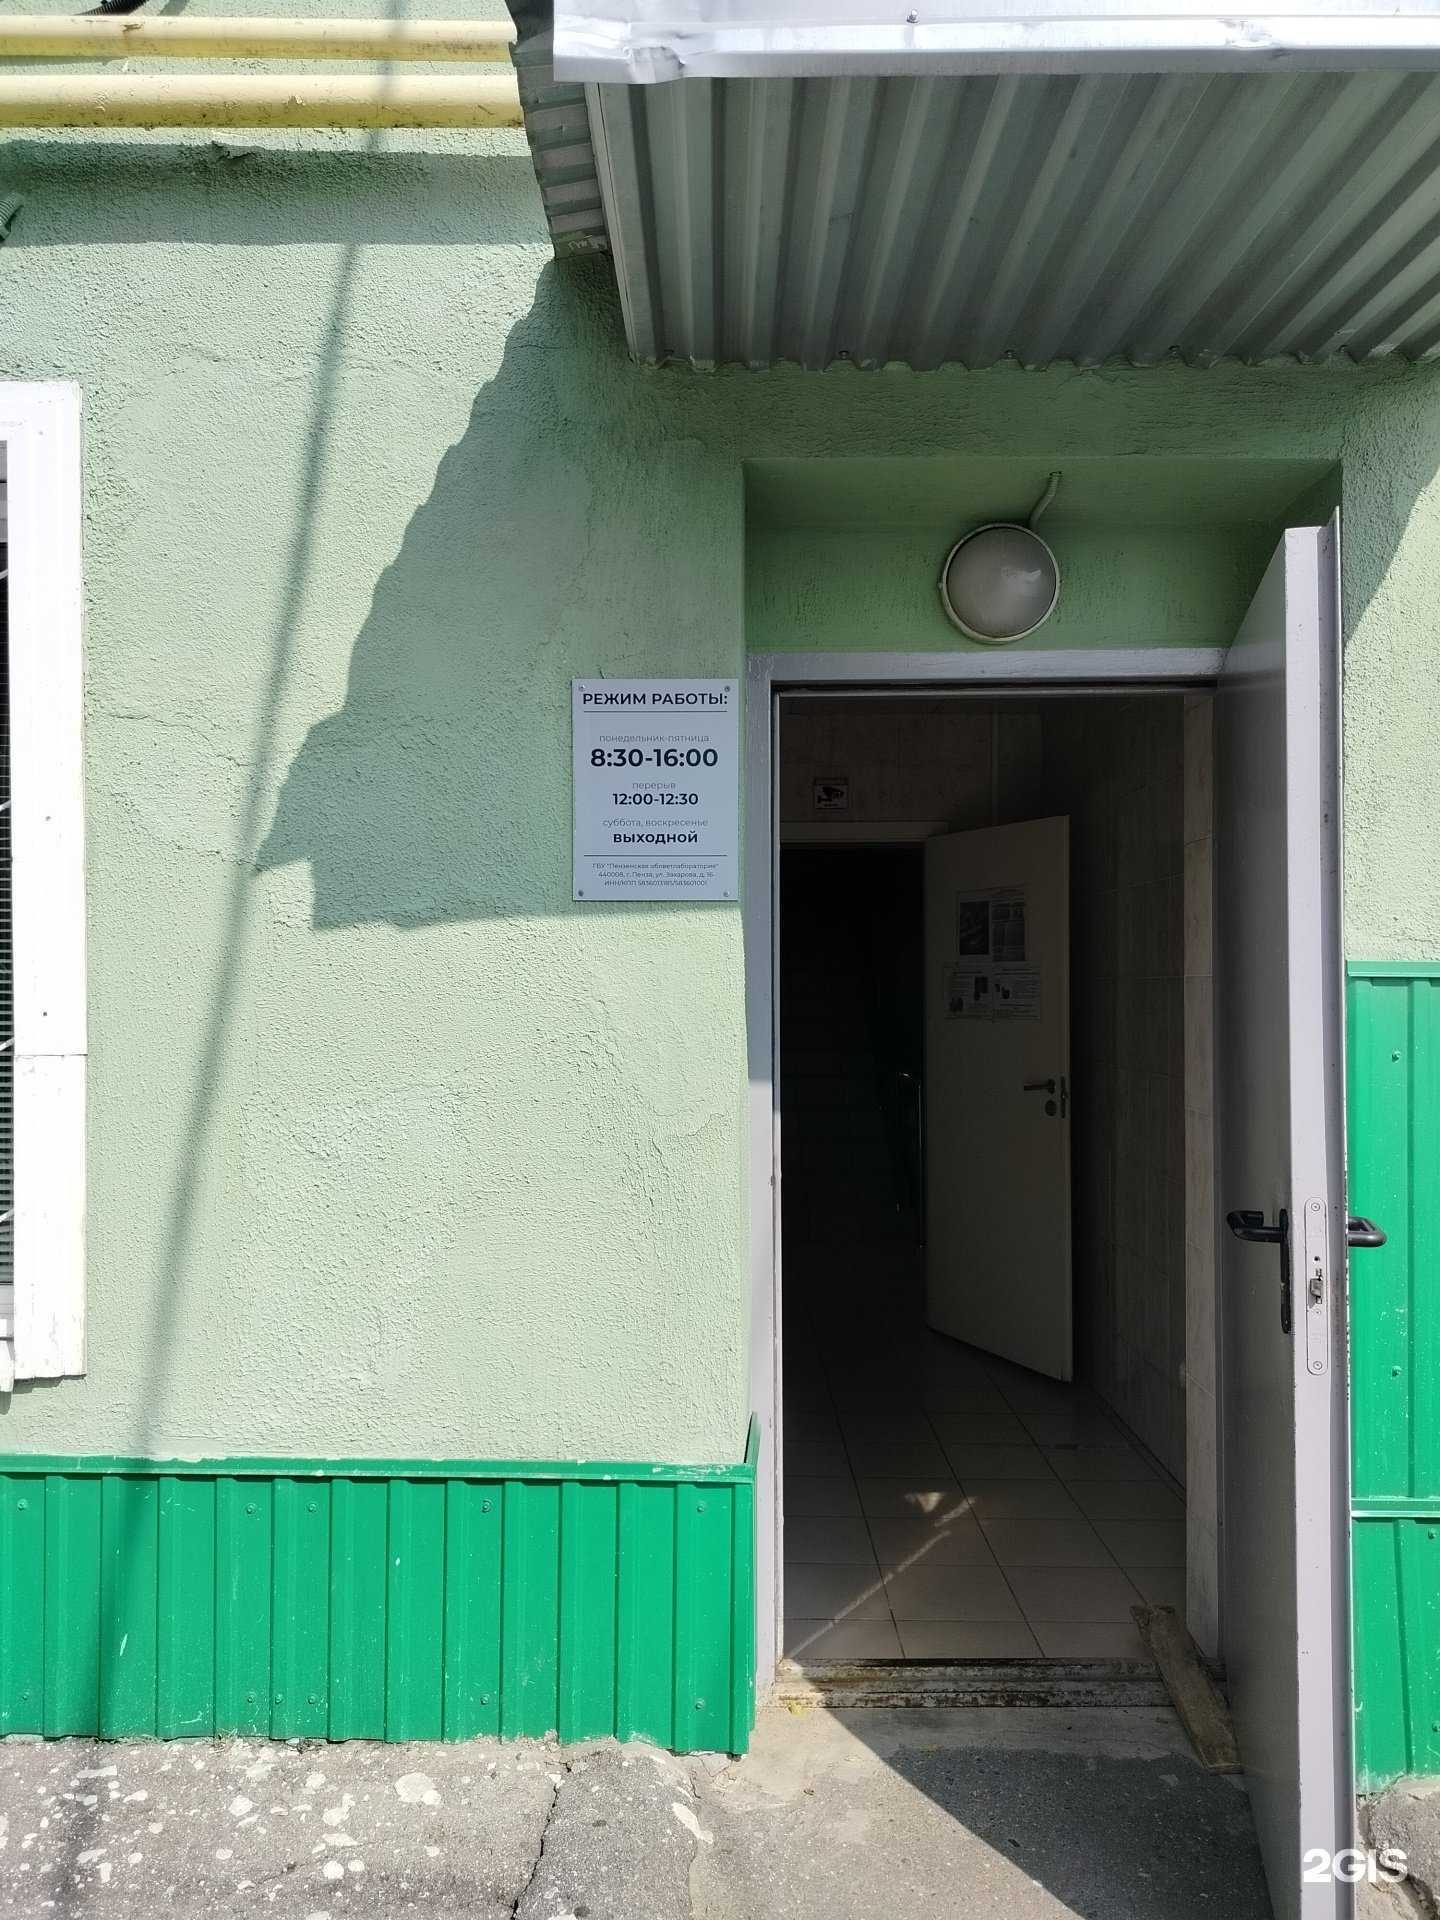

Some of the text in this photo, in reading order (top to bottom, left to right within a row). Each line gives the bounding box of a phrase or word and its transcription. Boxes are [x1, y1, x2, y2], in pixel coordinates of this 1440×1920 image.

[583, 693, 728, 705] РЕЖИМ РАБОТЫ:
[599, 735, 710, 743] понедельник-пятница
[590, 748, 719, 767] 8:30-16:00
[632, 782, 676, 791] перерыв
[612, 793, 699, 805] 12:00-12:30
[602, 818, 708, 828] суббота, воскресенье
[613, 830, 698, 845] выходной
